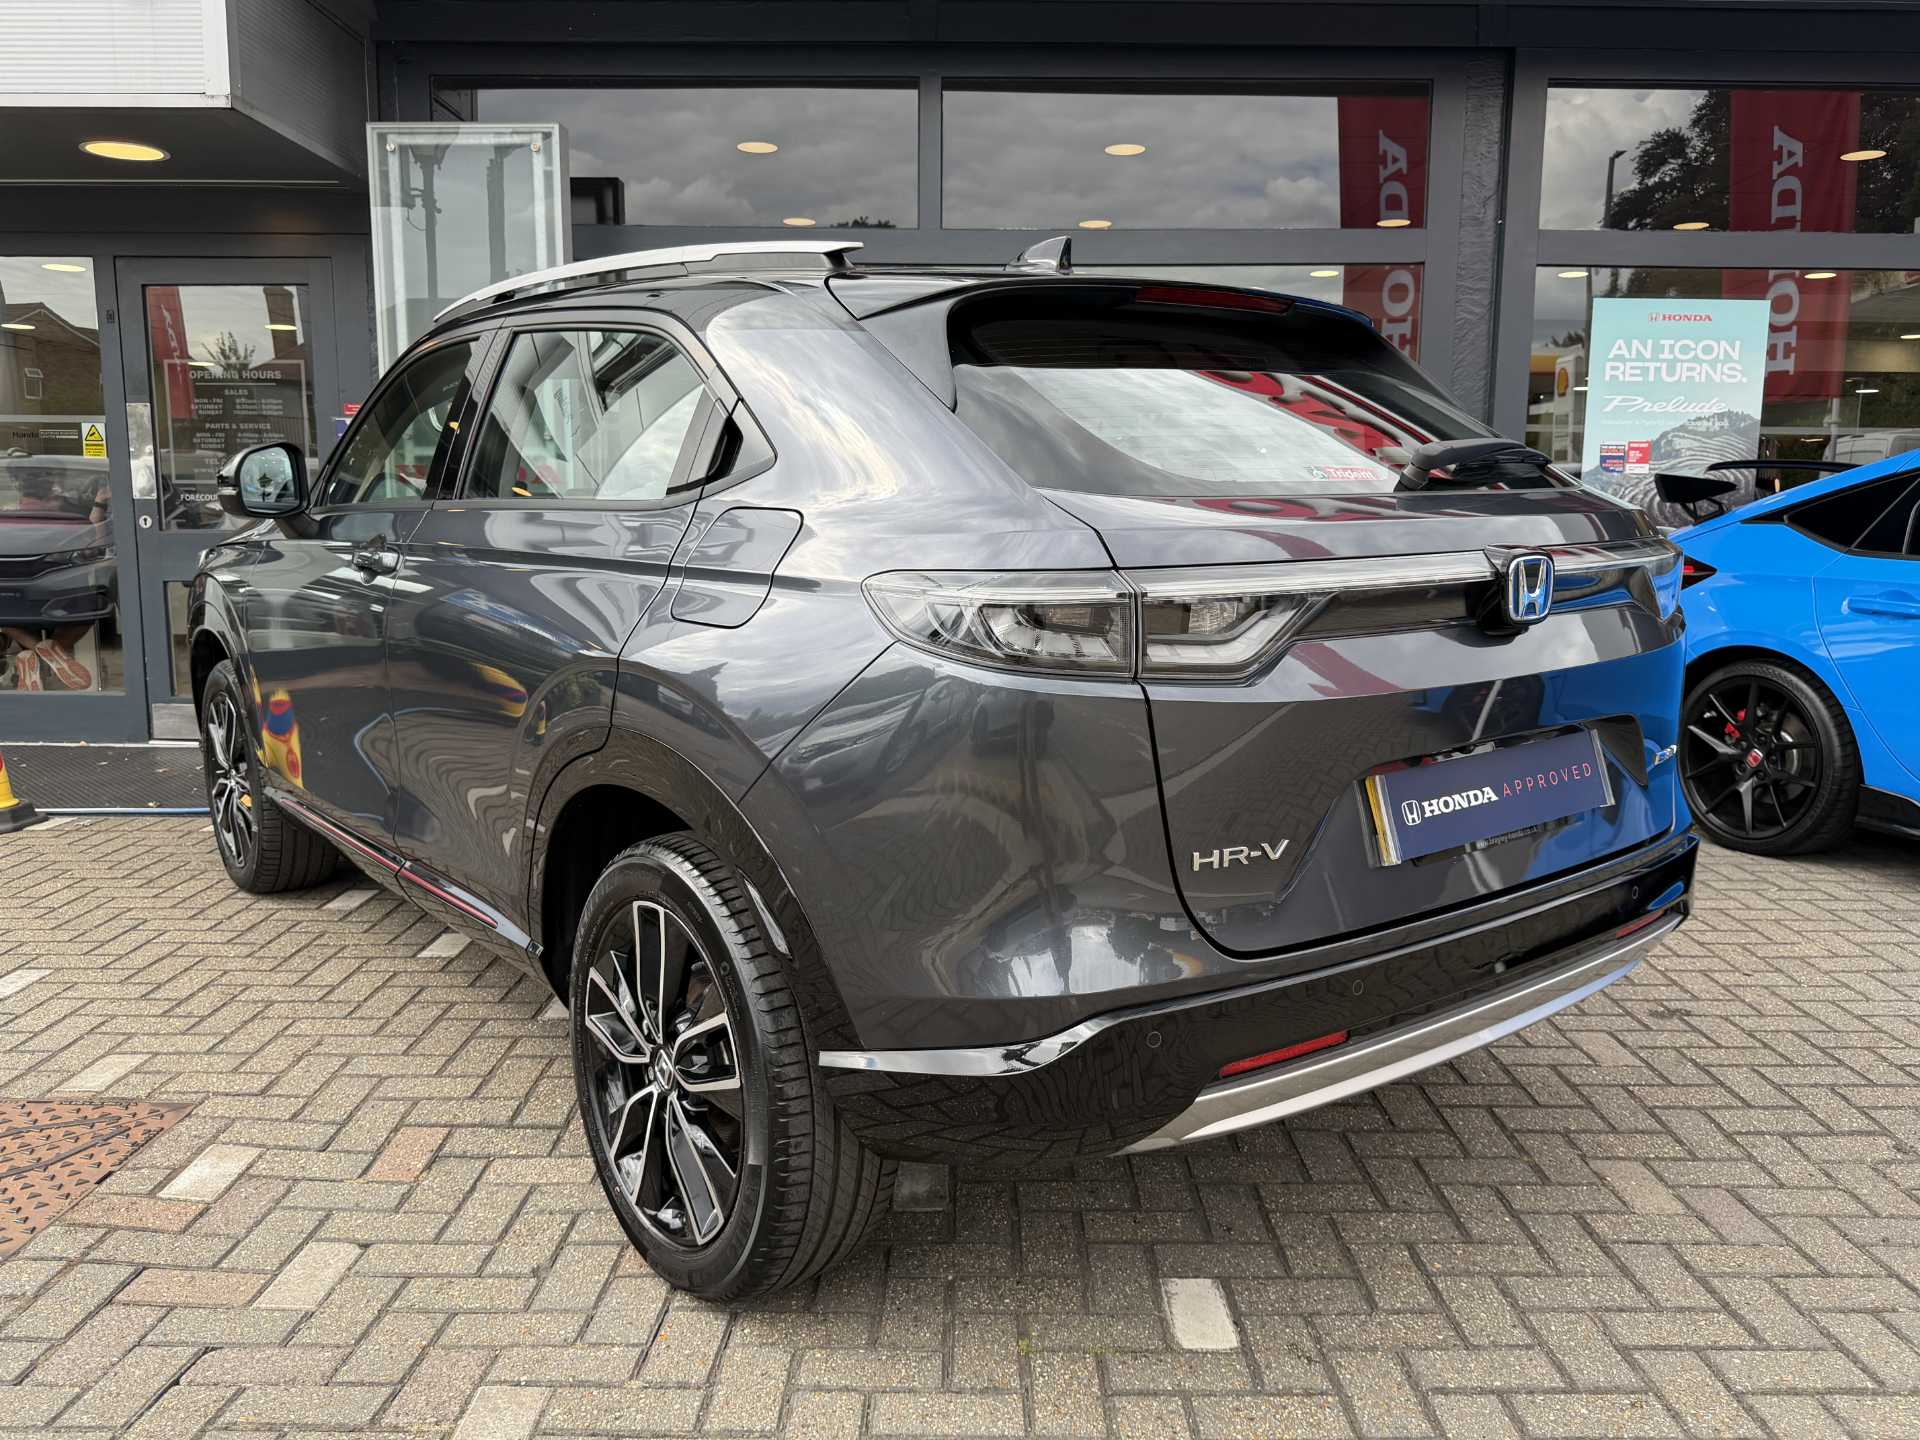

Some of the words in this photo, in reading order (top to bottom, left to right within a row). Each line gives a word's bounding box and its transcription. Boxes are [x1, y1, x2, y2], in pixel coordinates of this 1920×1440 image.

[1661, 313, 1713, 322] HONDA
[1607, 338, 1653, 360] AN
[1658, 339, 1741, 361] ICON
[189, 370, 239, 380] OPENING
[242, 370, 282, 380] HOURS
[1604, 361, 1748, 384] RETURNS.
[1602, 395, 1728, 413] Prelude
[1422, 786, 1499, 818] HONDA
[1502, 762, 1593, 798] APPROVED
[1192, 838, 1290, 872] HR-V
